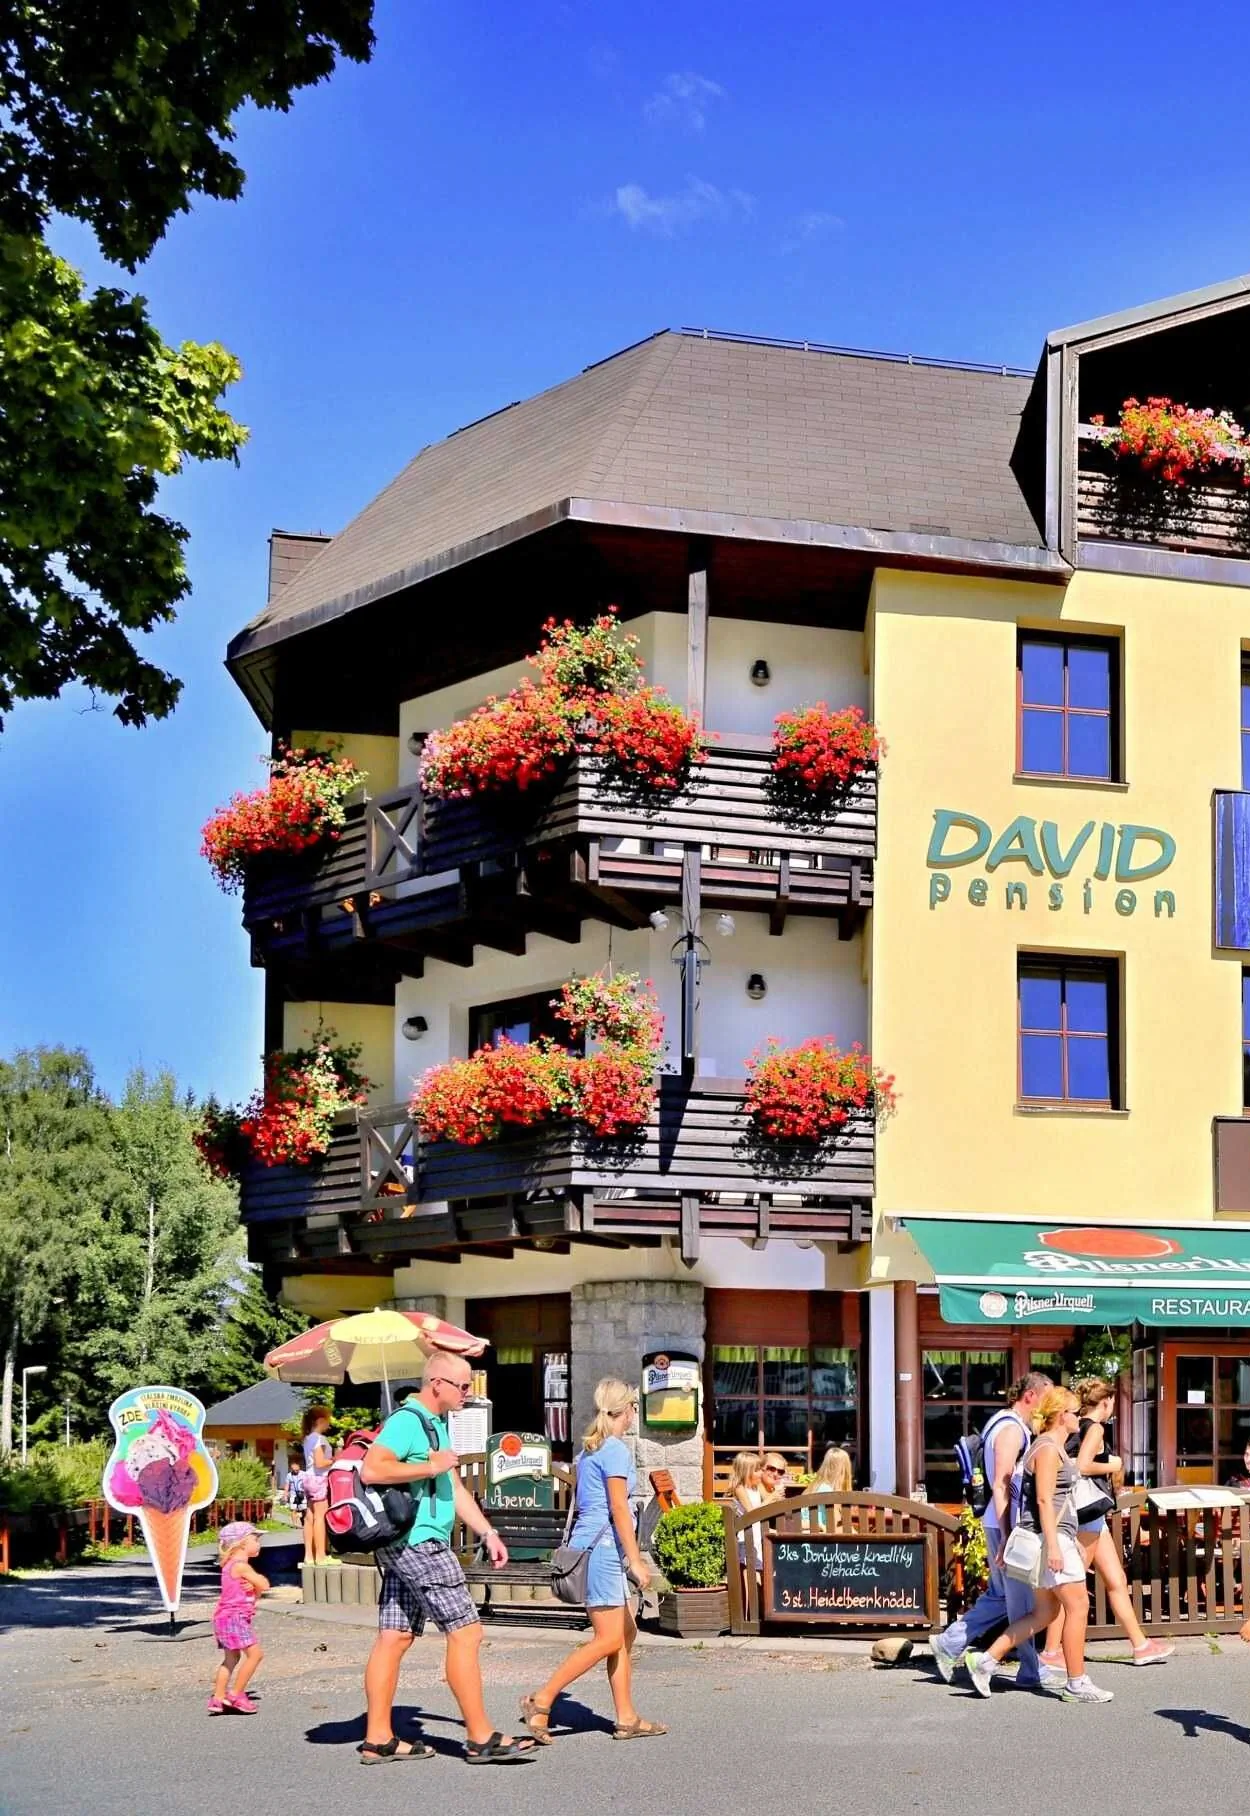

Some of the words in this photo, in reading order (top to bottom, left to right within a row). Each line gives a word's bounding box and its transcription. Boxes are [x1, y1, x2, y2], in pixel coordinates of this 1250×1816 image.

[926, 809, 1177, 883] DAVID
[929, 873, 1176, 917] pension
[1023, 1250, 1198, 1274] Pilsner
[1014, 1291, 1056, 1318] Pilsner
[1054, 1292, 1096, 1312] Urquell
[119, 1410, 143, 1426] ZDE
